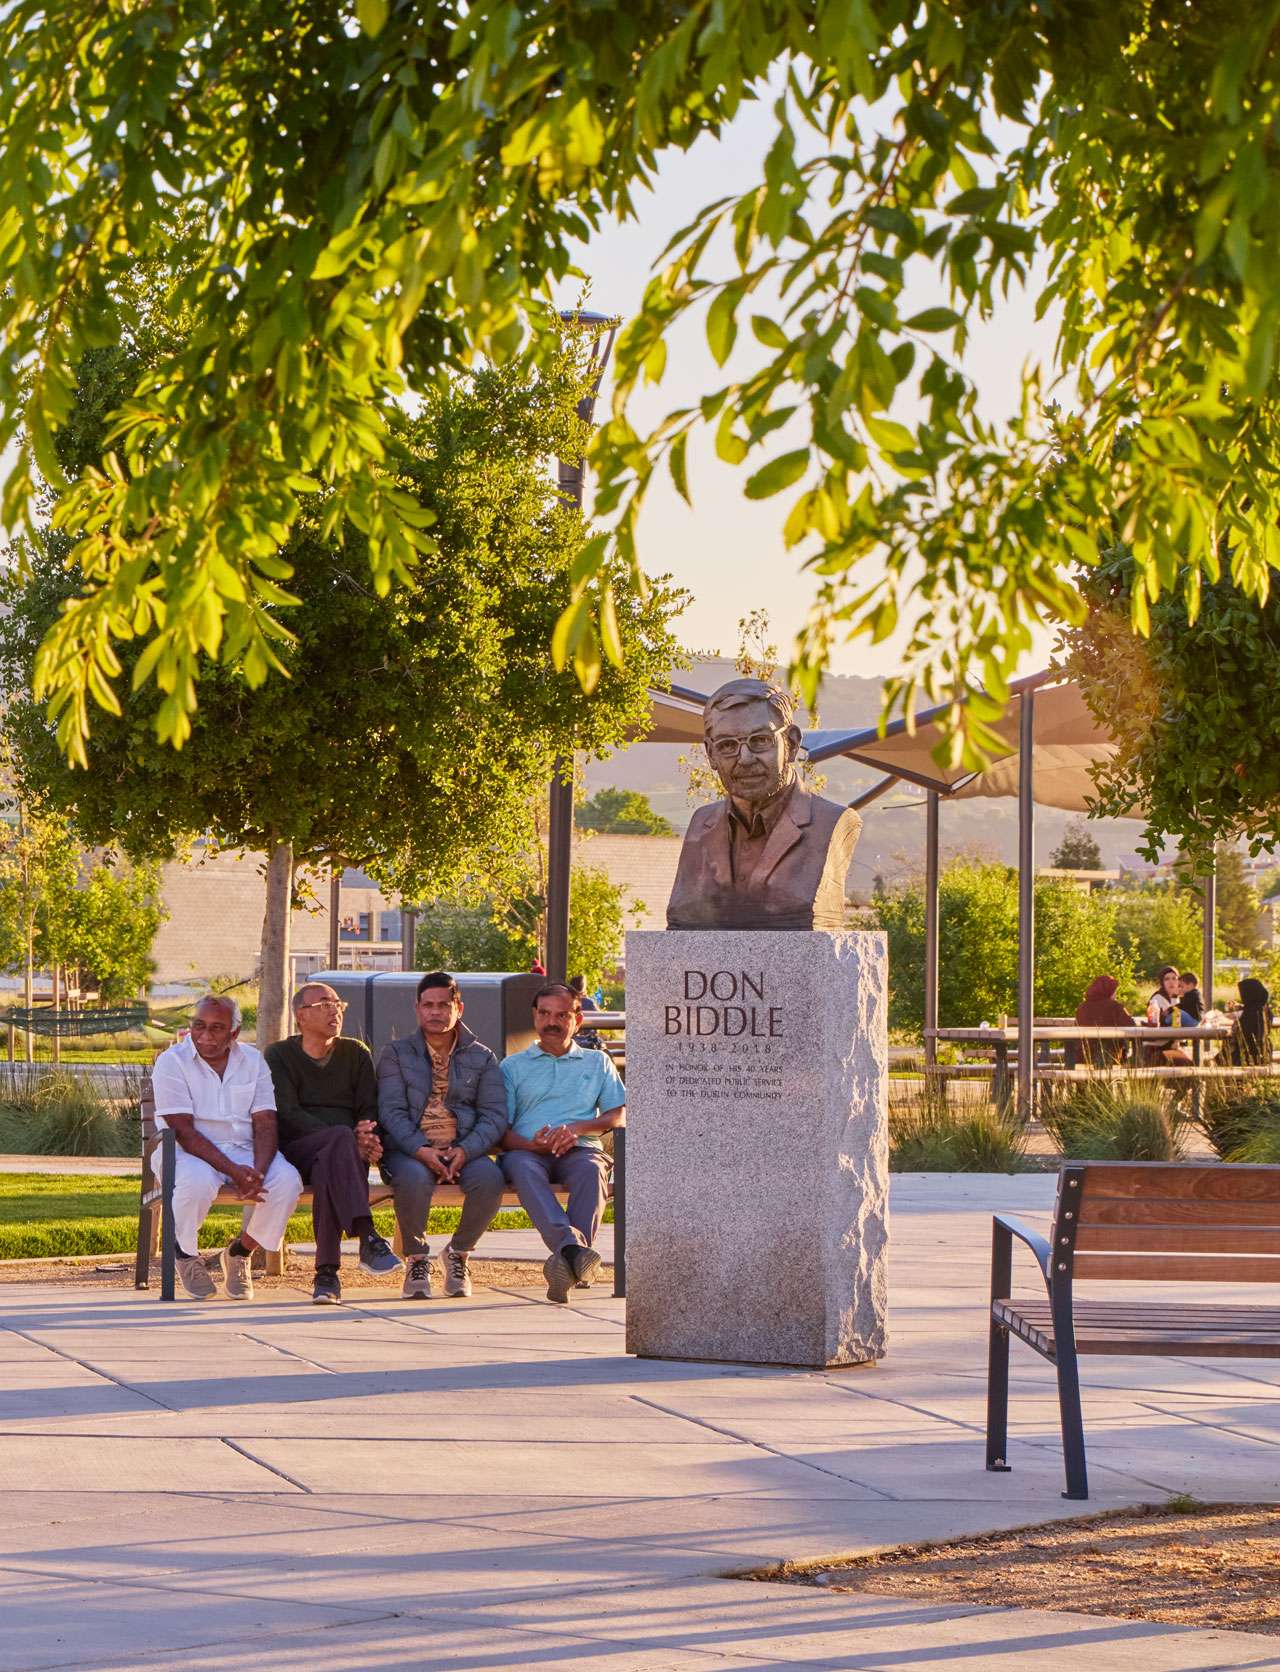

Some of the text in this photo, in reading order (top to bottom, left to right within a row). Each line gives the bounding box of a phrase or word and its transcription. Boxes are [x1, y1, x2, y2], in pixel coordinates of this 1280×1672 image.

[684, 970, 764, 1001] DON
[664, 1005, 784, 1037] BIDDLE
[679, 1064, 708, 1072] HONOR
[746, 1065, 756, 1073] 40
[760, 1065, 783, 1073] YEARS
[665, 1076, 782, 1087] OF DEDICATED PUBLIC SERVICE
[666, 1089, 782, 1100] TO THE DUBLIN COMMUNITY
